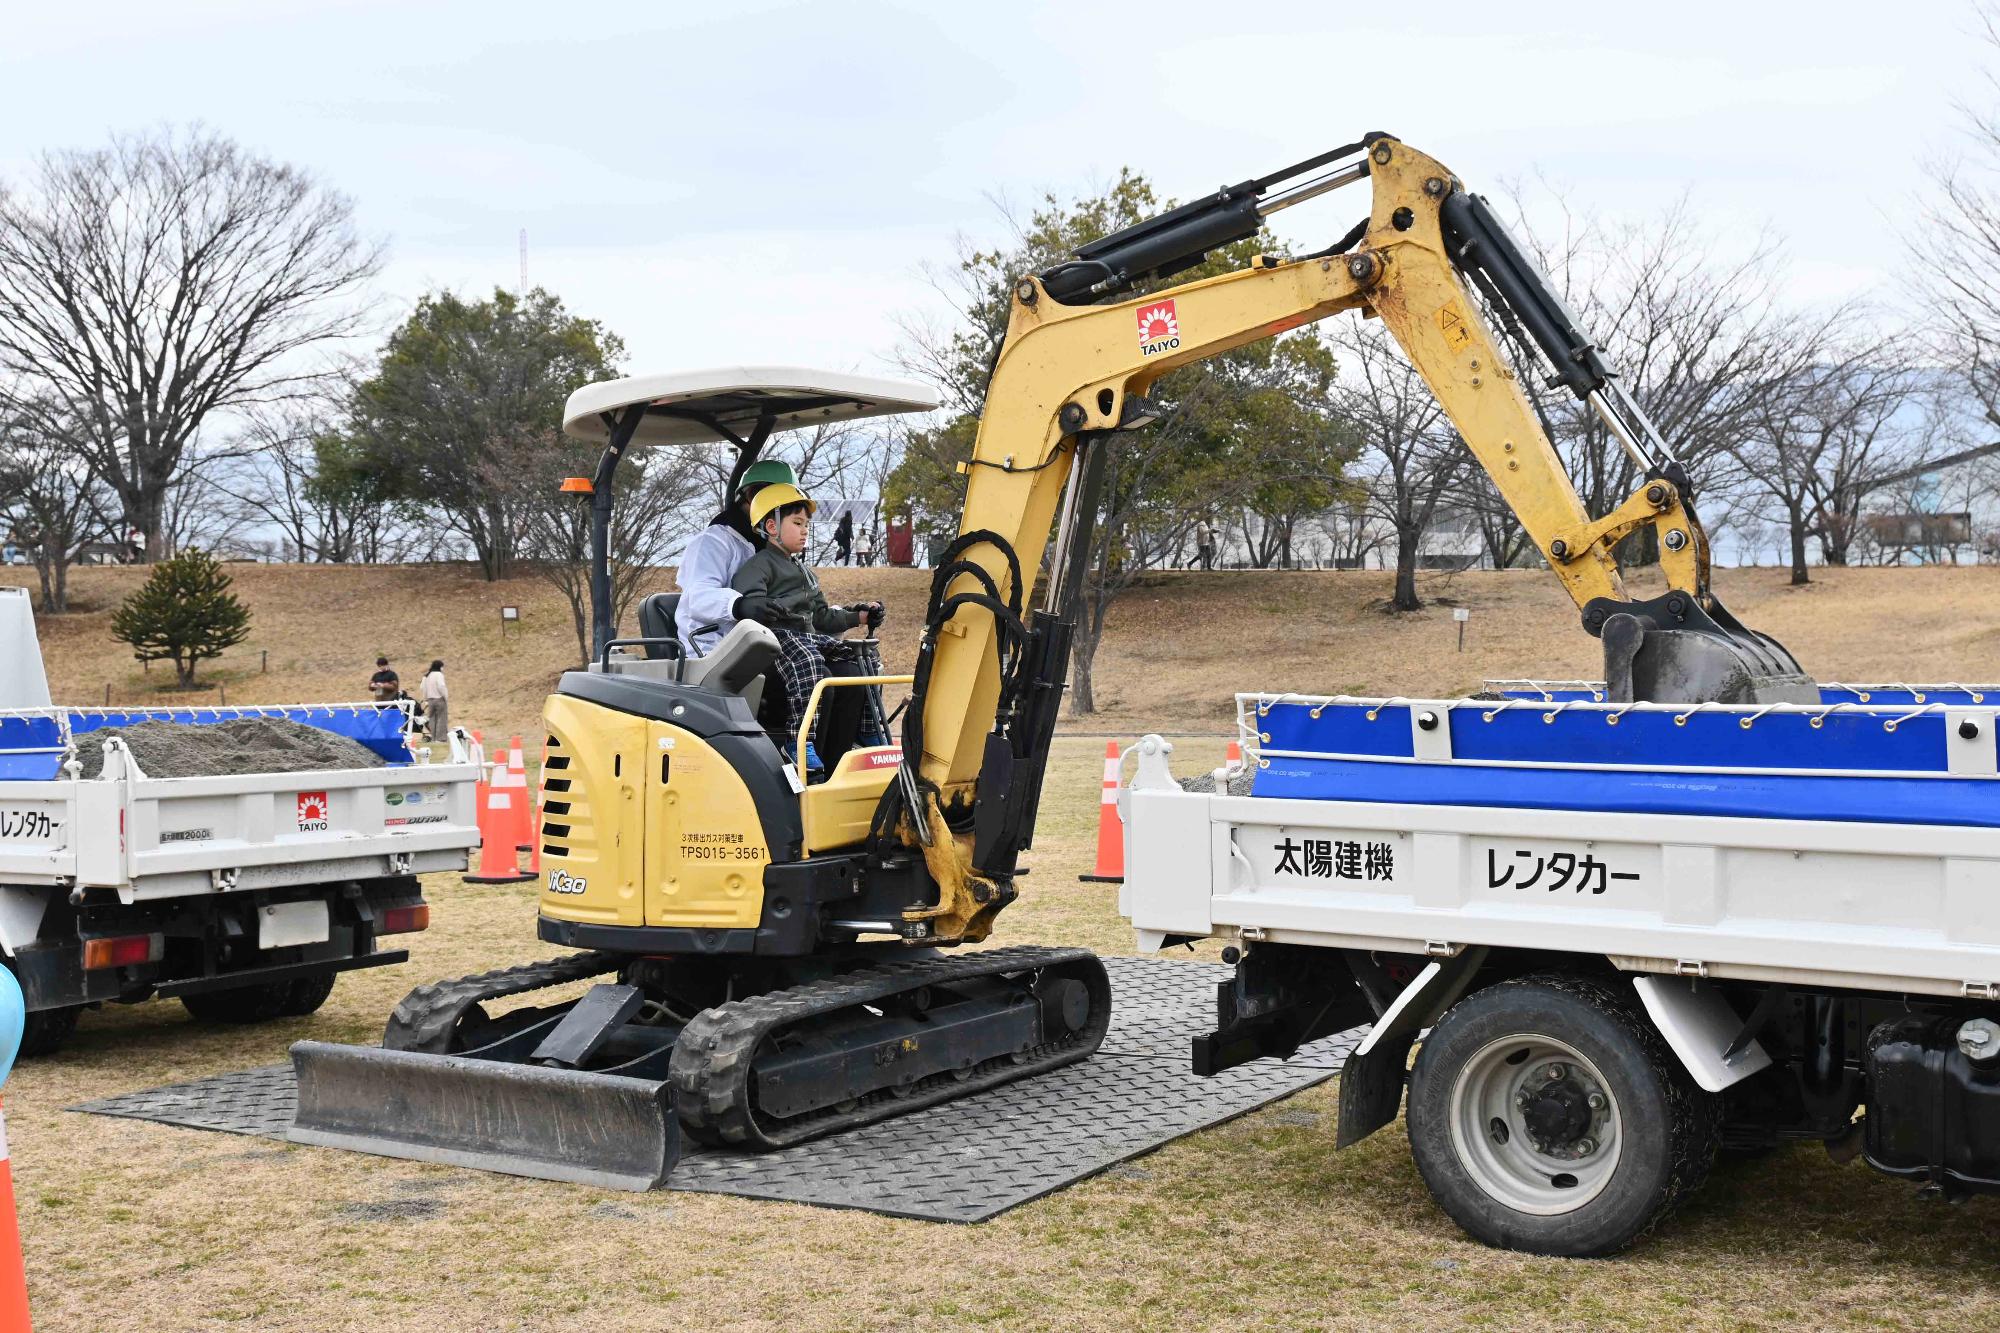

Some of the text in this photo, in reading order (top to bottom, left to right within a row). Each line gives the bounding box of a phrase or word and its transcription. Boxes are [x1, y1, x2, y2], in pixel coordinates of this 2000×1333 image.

[1141, 338, 1179, 355] TAIYO
[1, 811, 59, 838] レンタカー
[298, 822, 328, 832] TAIYO
[680, 846, 765, 860] TPS015-3561
[1274, 837, 1641, 895] 太陽建機 レンタカー
